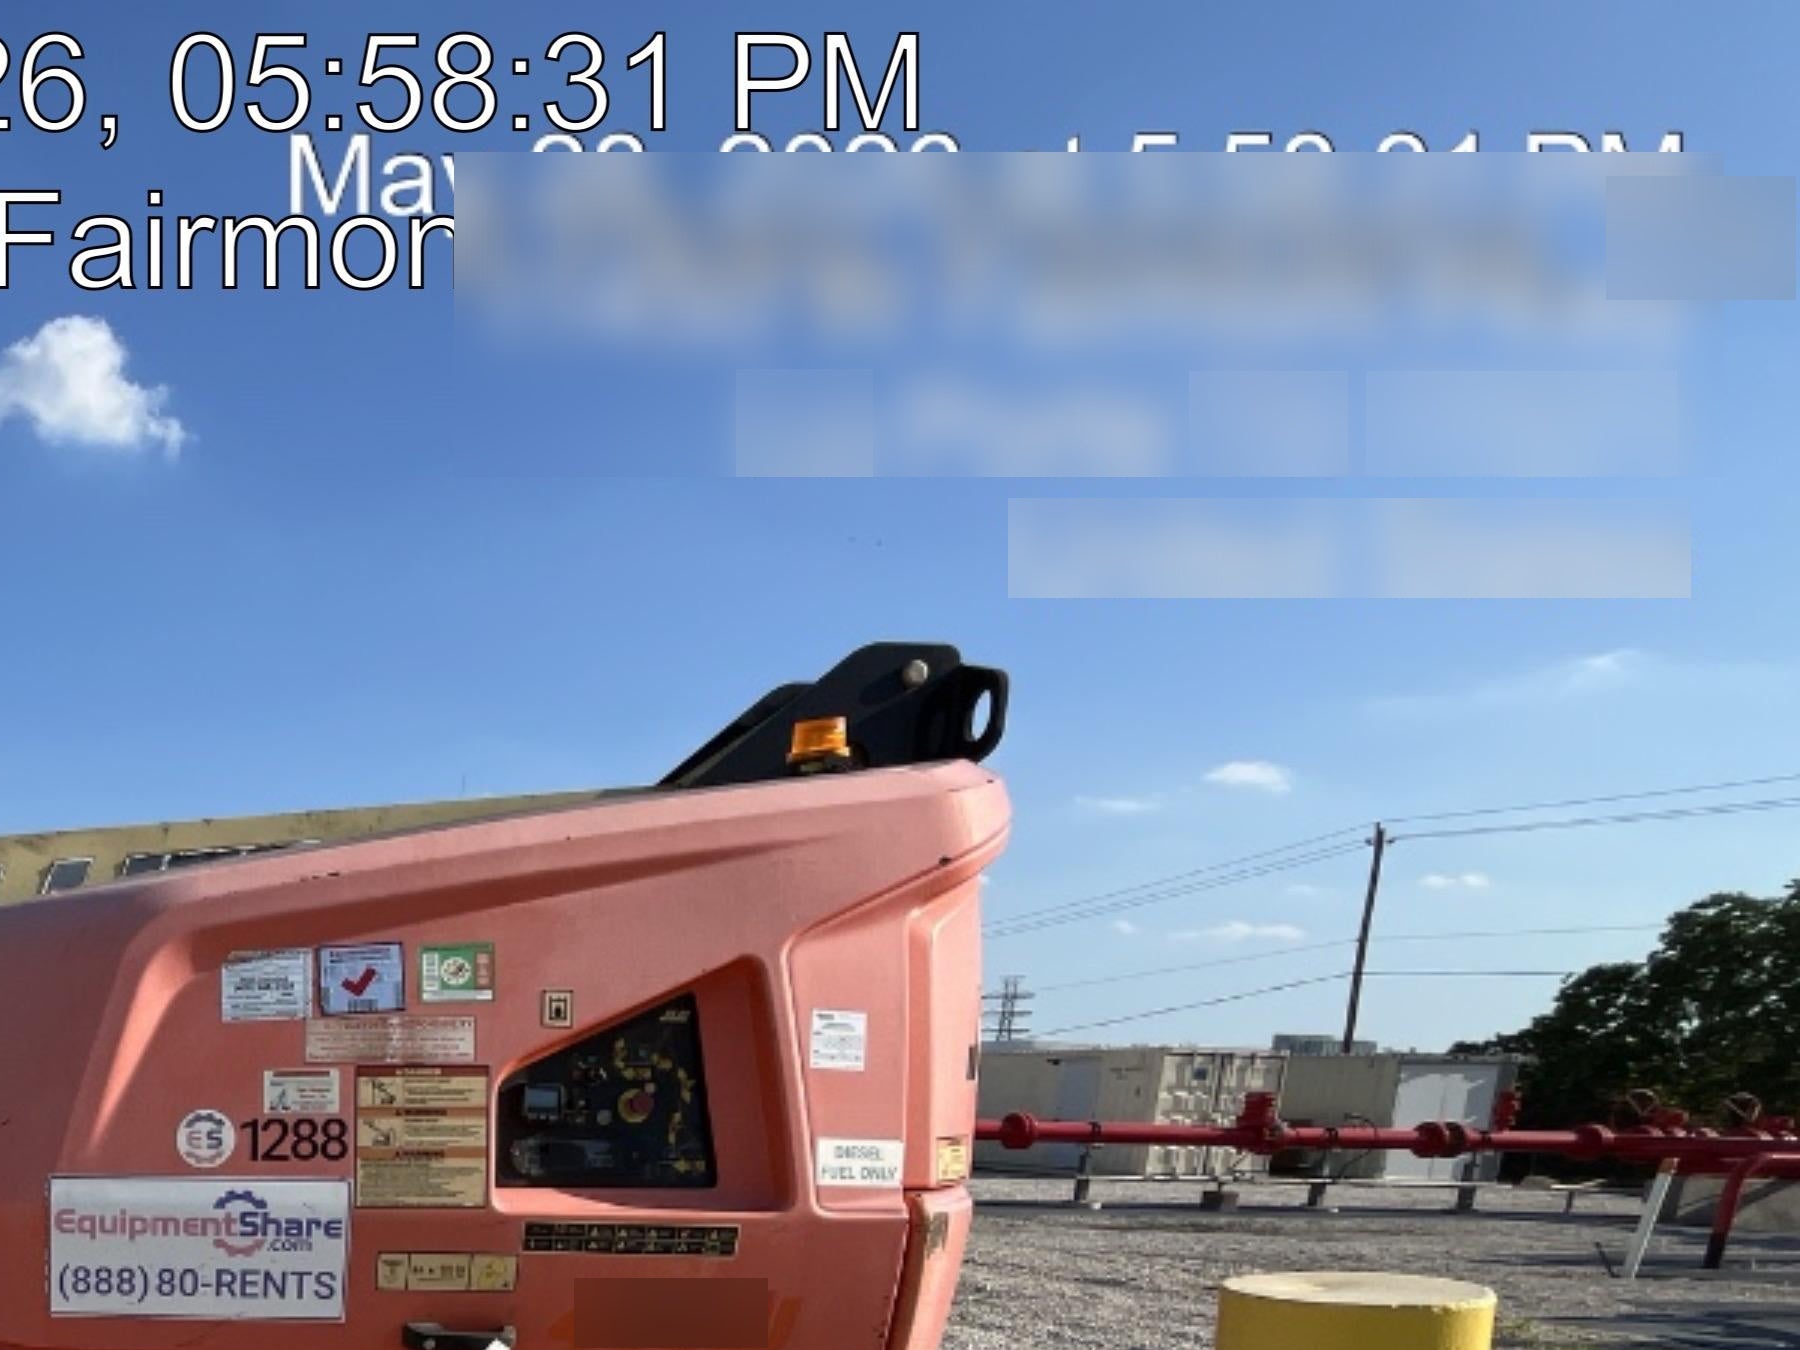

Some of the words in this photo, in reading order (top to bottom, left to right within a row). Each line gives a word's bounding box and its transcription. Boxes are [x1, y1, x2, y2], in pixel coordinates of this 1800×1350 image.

[239, 1117, 349, 1162] 1288
[821, 1165, 856, 1180] FUEL
[860, 1166, 898, 1180] ONLY
[53, 1208, 343, 1241] EquipmentShare
[266, 1238, 313, 1252] .com
